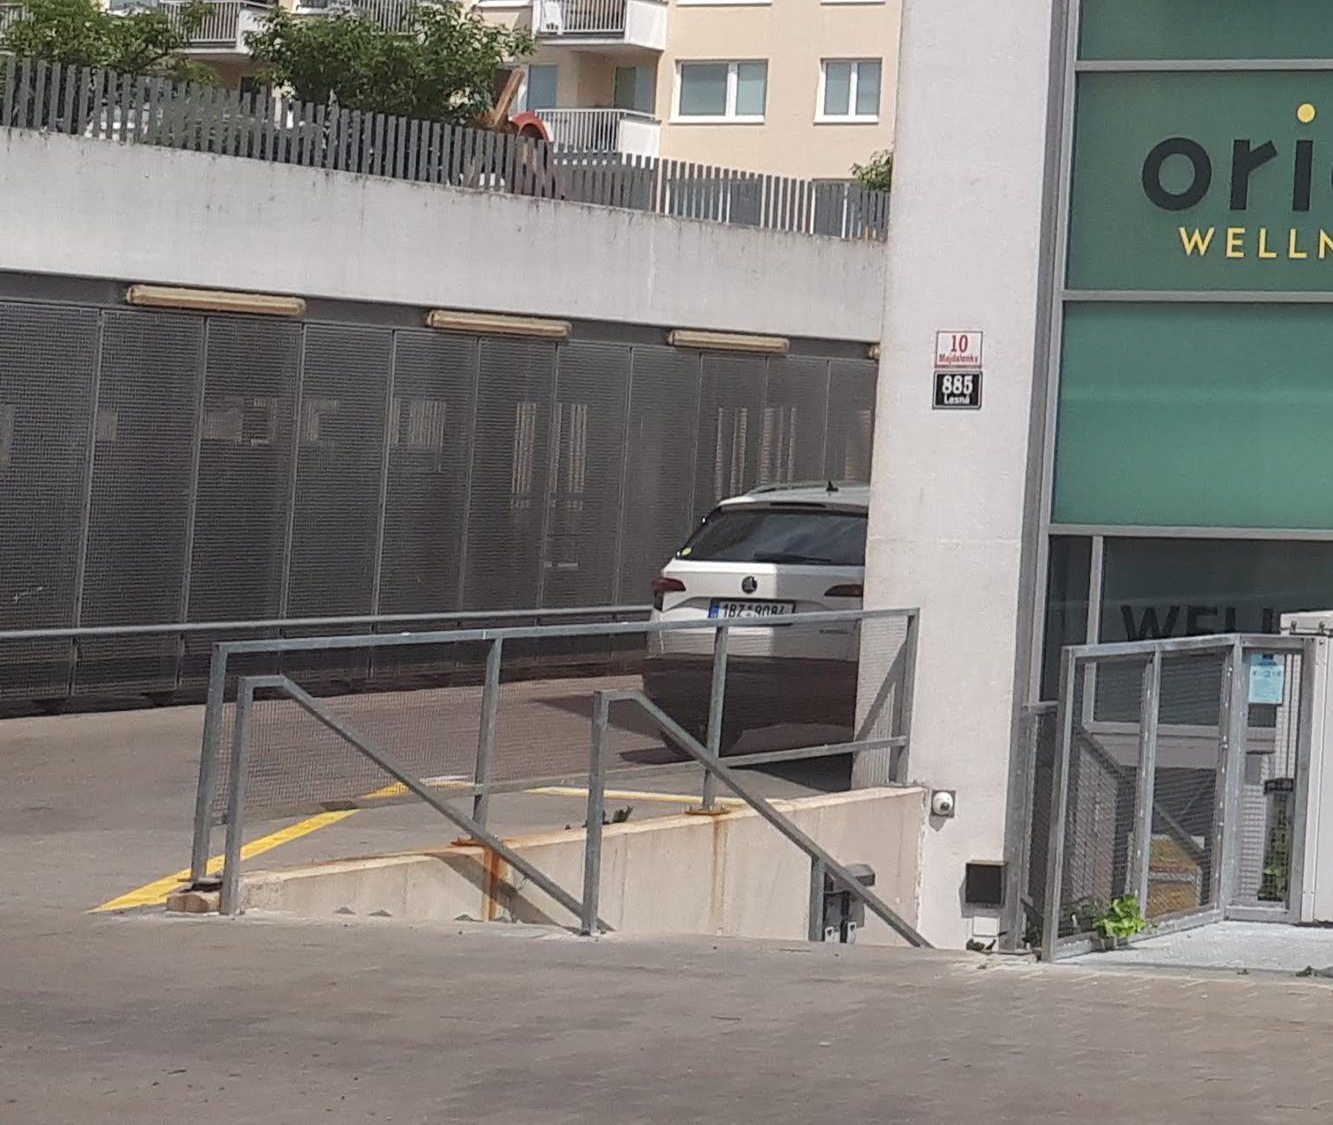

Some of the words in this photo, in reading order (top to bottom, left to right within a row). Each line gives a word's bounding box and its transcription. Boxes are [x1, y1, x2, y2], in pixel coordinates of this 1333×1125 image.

[951, 335, 968, 352] 10
[942, 375, 973, 394] 885
[944, 393, 970, 405] Lesná
